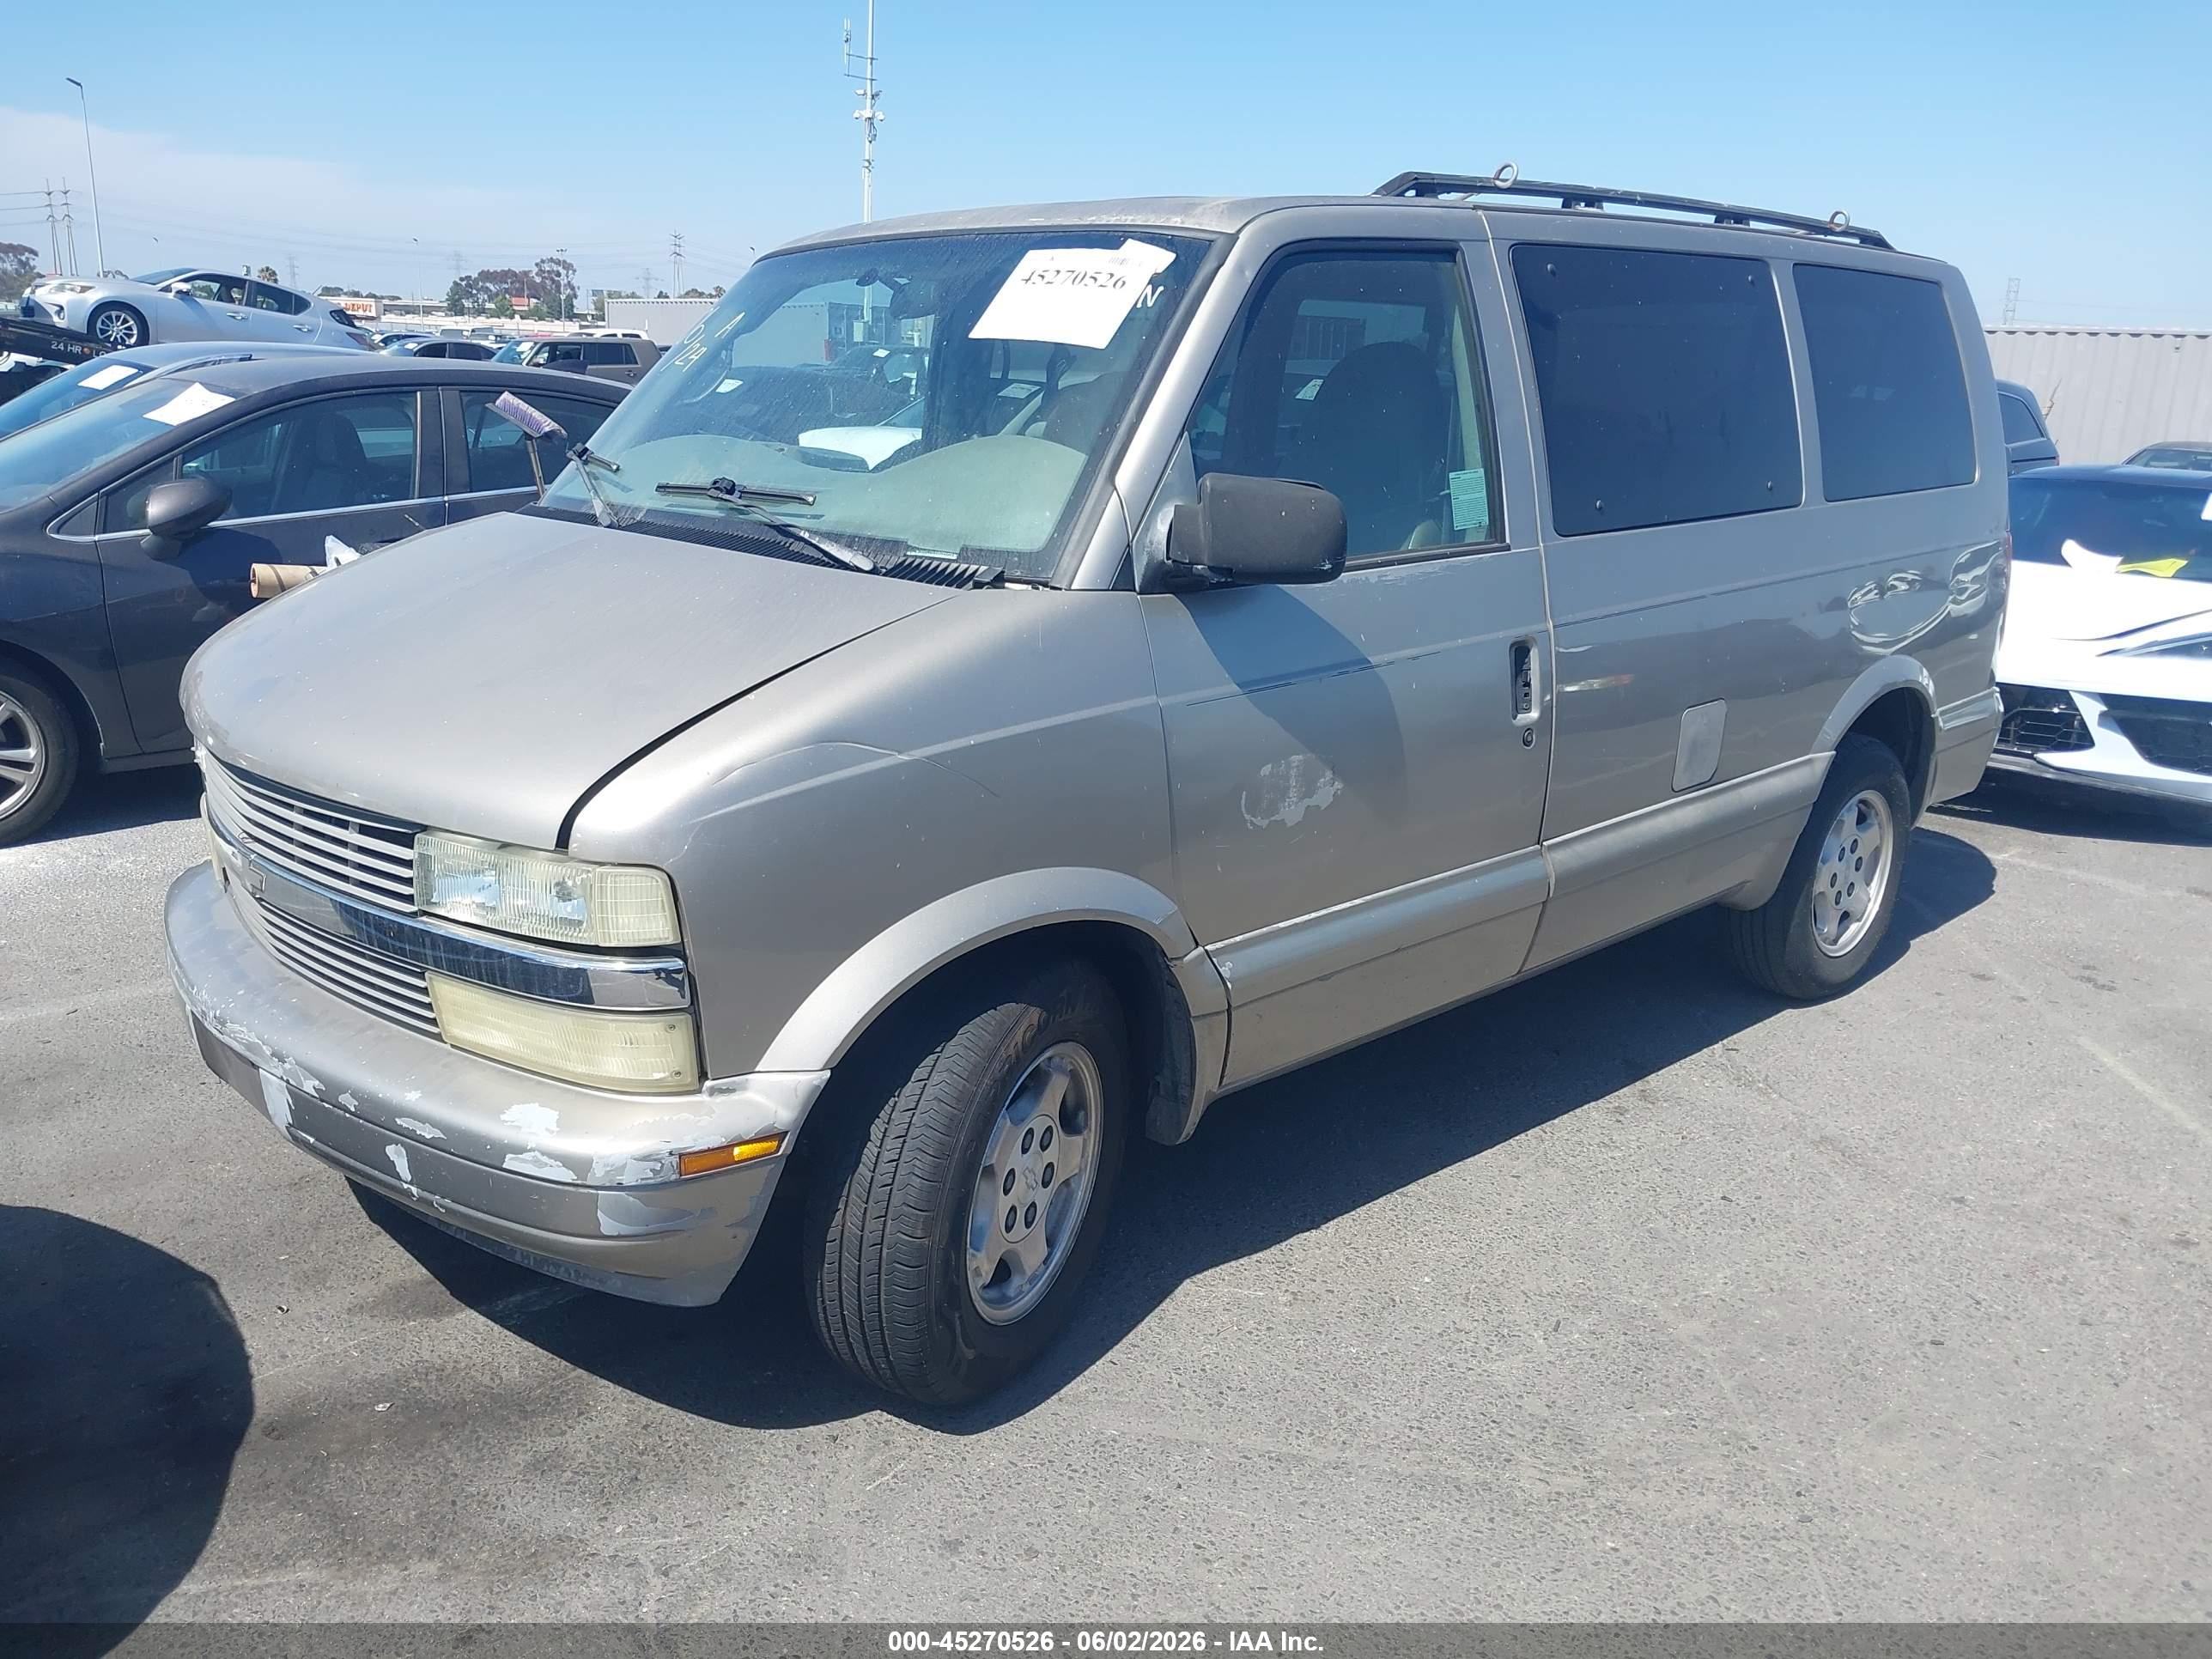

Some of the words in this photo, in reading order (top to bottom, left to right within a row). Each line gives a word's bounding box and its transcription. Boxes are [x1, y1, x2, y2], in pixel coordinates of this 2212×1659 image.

[1020, 269, 1127, 290] 45270526
[51, 341, 64, 351] 24
[67, 343, 82, 355] HR
